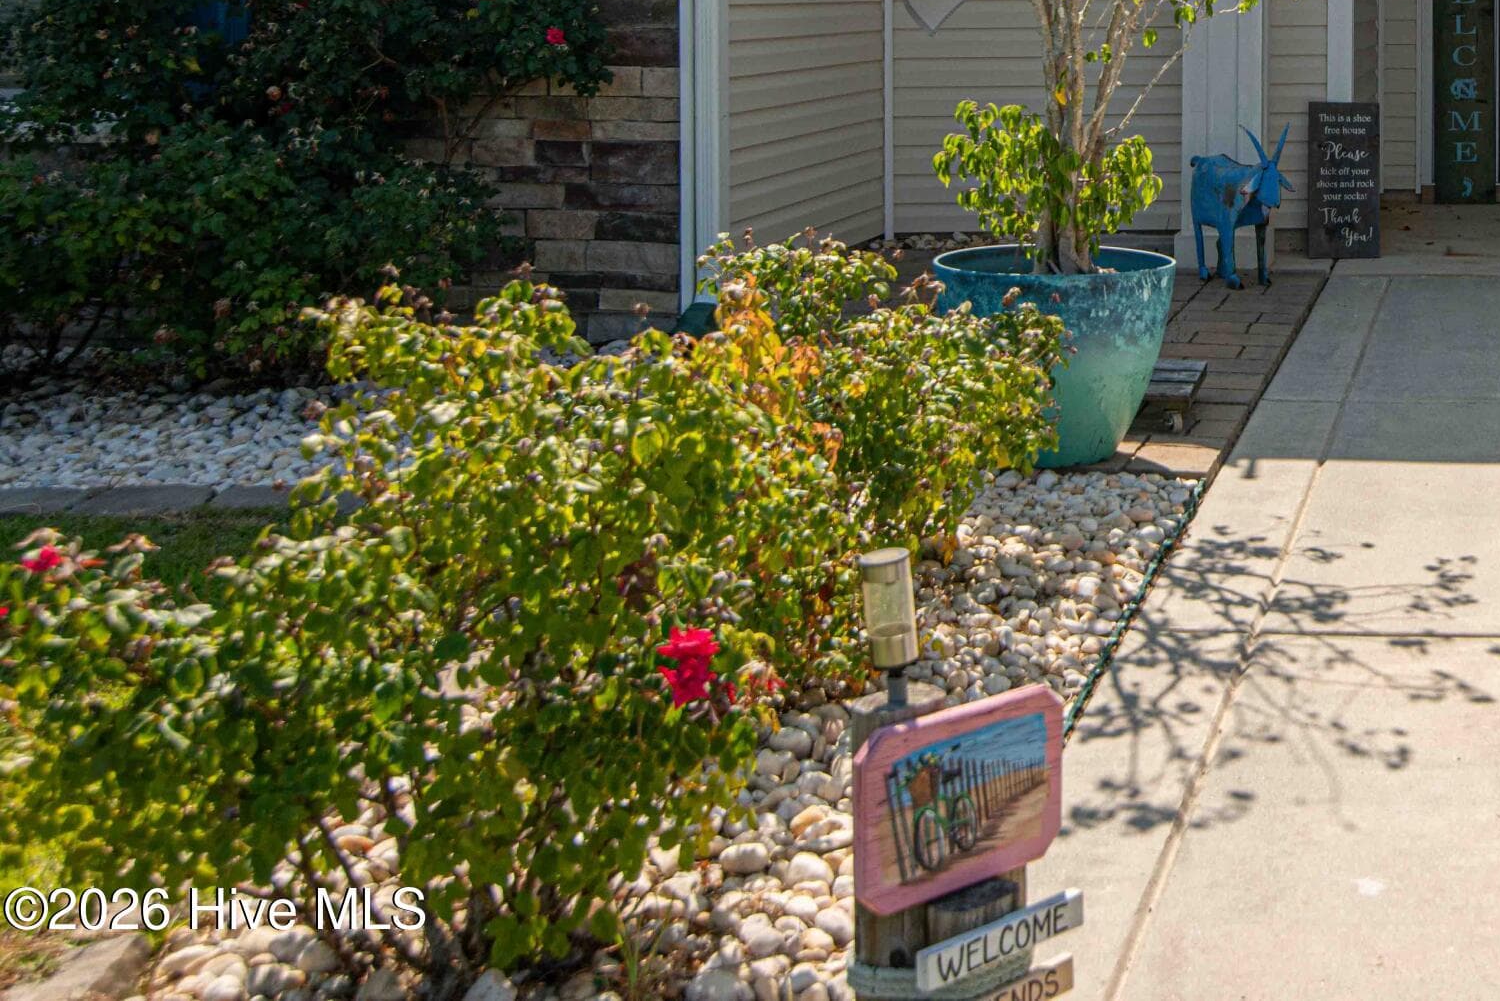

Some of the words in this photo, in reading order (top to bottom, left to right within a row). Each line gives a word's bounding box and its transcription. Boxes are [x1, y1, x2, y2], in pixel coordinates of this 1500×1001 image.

[1319, 112, 1336, 122] This
[1337, 112, 1345, 122] is
[1352, 113, 1372, 122] shoe
[1324, 125, 1340, 135] free
[1342, 125, 1366, 135] house
[1321, 140, 1370, 162] Please
[1320, 167, 1337, 176] kick
[1338, 167, 1350, 176] off
[1351, 168, 1370, 177] your
[1316, 180, 1338, 189] shoes
[1339, 180, 1355, 189] and
[1356, 180, 1375, 189] rock
[1323, 193, 1342, 202] your
[1318, 207, 1361, 225] Thank
[1341, 226, 1373, 247] You!
[937, 902, 1068, 982] WELCOME
